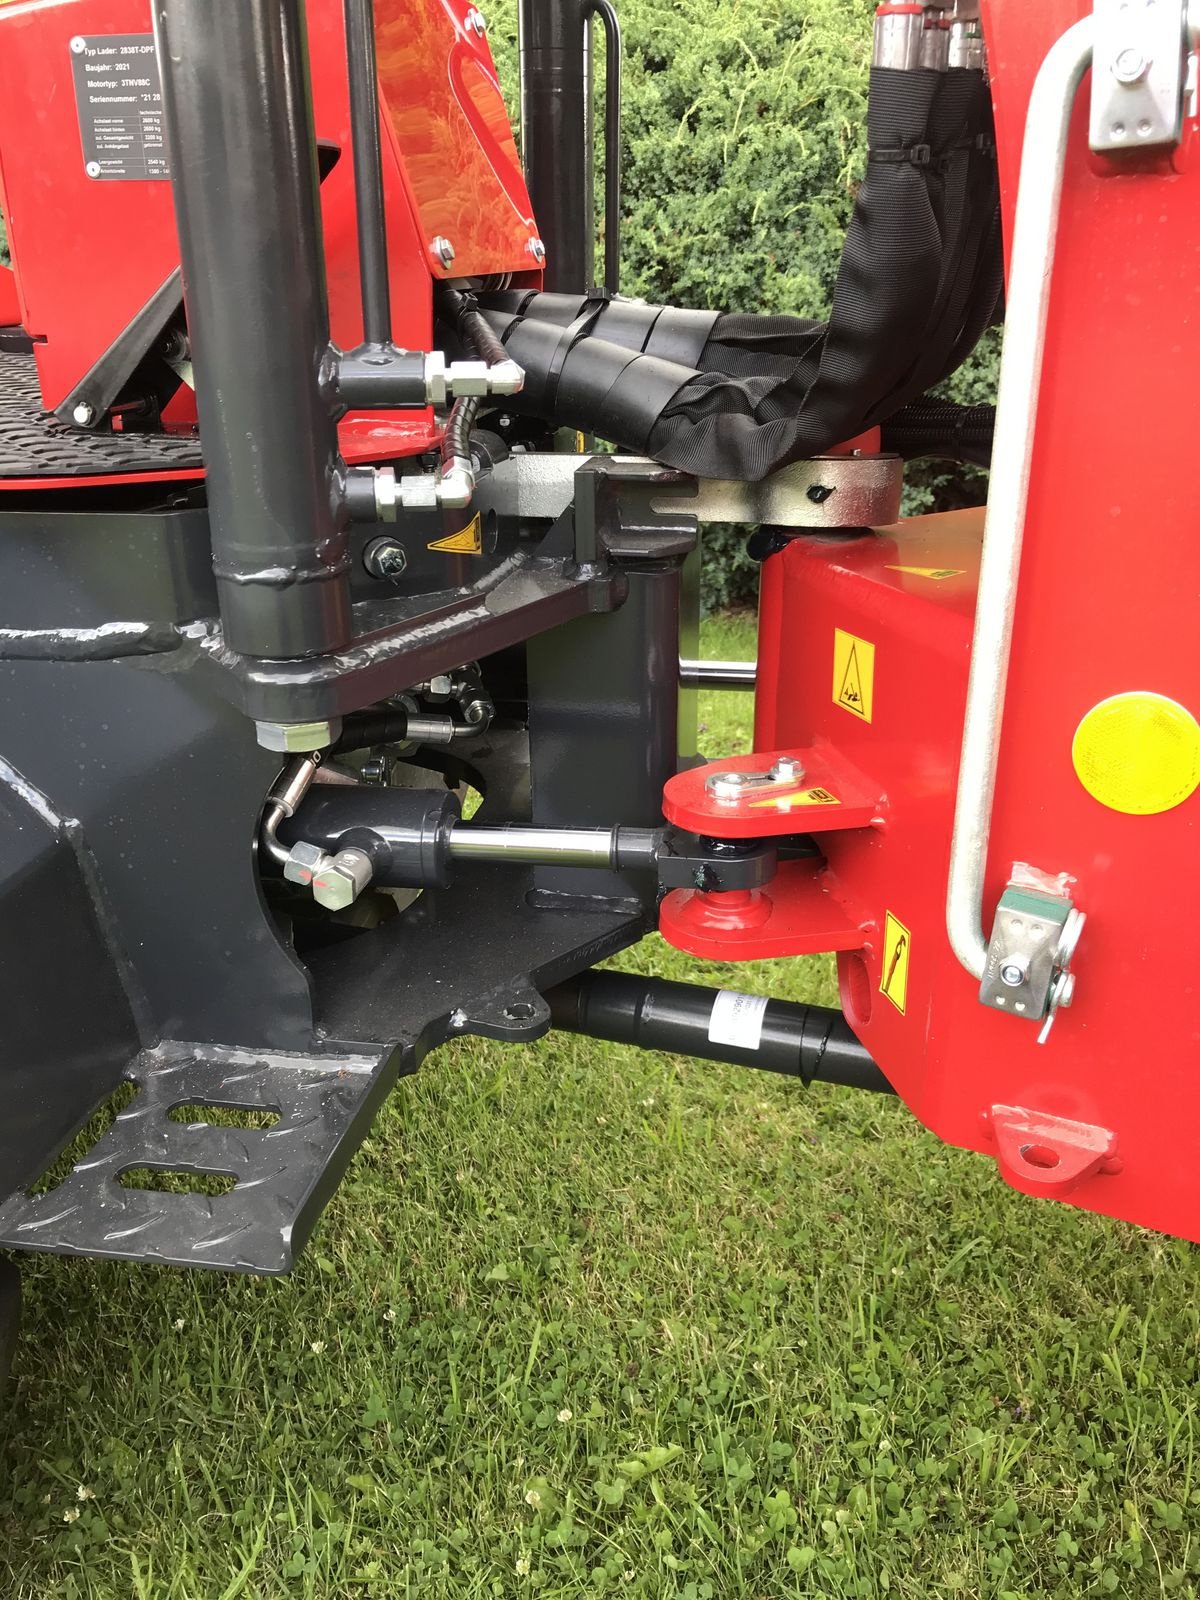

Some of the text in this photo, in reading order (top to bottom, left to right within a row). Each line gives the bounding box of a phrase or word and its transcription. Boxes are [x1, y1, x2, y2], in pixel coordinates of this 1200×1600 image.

[85, 45, 155, 56] Typ Lader: 2838T-DPF
[85, 63, 130, 72] Baujahr: 2021
[87, 80, 118, 88] Motortyp:
